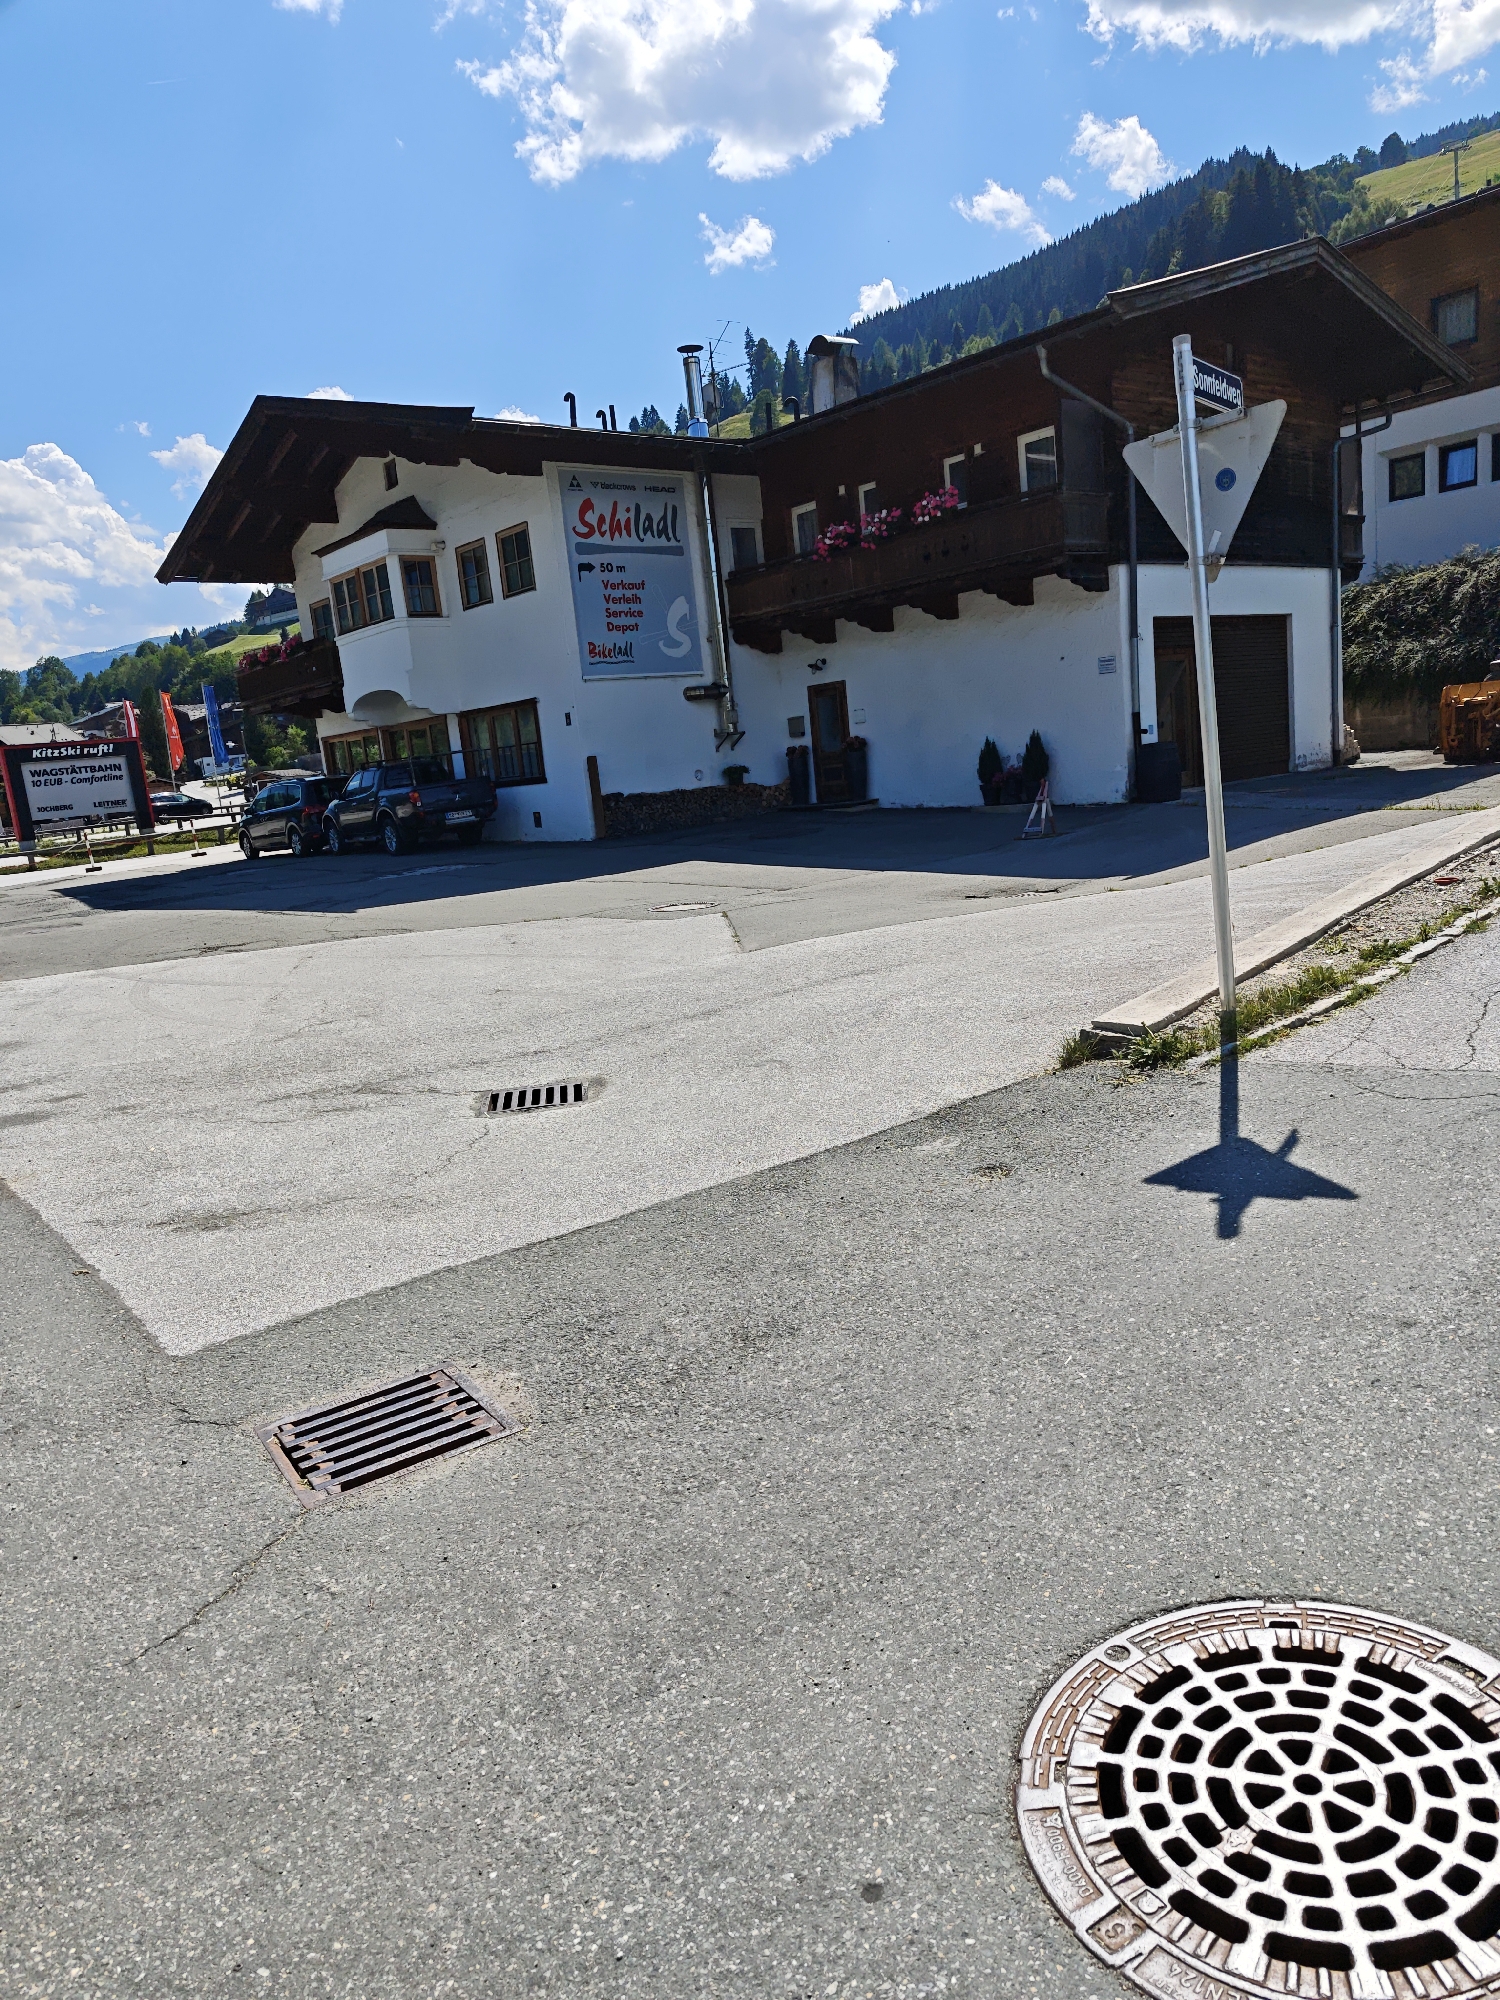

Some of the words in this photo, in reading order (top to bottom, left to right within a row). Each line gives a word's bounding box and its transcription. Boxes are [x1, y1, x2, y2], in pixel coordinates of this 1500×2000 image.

[644, 485, 676, 493] HEAD
[572, 497, 681, 543] Schiladl
[600, 563, 613, 573] 50
[616, 565, 626, 573] m
[602, 579, 645, 590] Verkauf
[603, 593, 642, 604] Verleih
[605, 607, 644, 618] Service
[607, 622, 639, 634] Depot
[588, 641, 634, 659] Bikeladl
[32, 745, 80, 758] KitzSki
[83, 743, 114, 756] ruft!
[29, 763, 122, 778] WAGSTÄTTBAHN
[31, 779, 42, 788] 10
[44, 777, 63, 787] EUB
[70, 773, 124, 785] Comfortline
